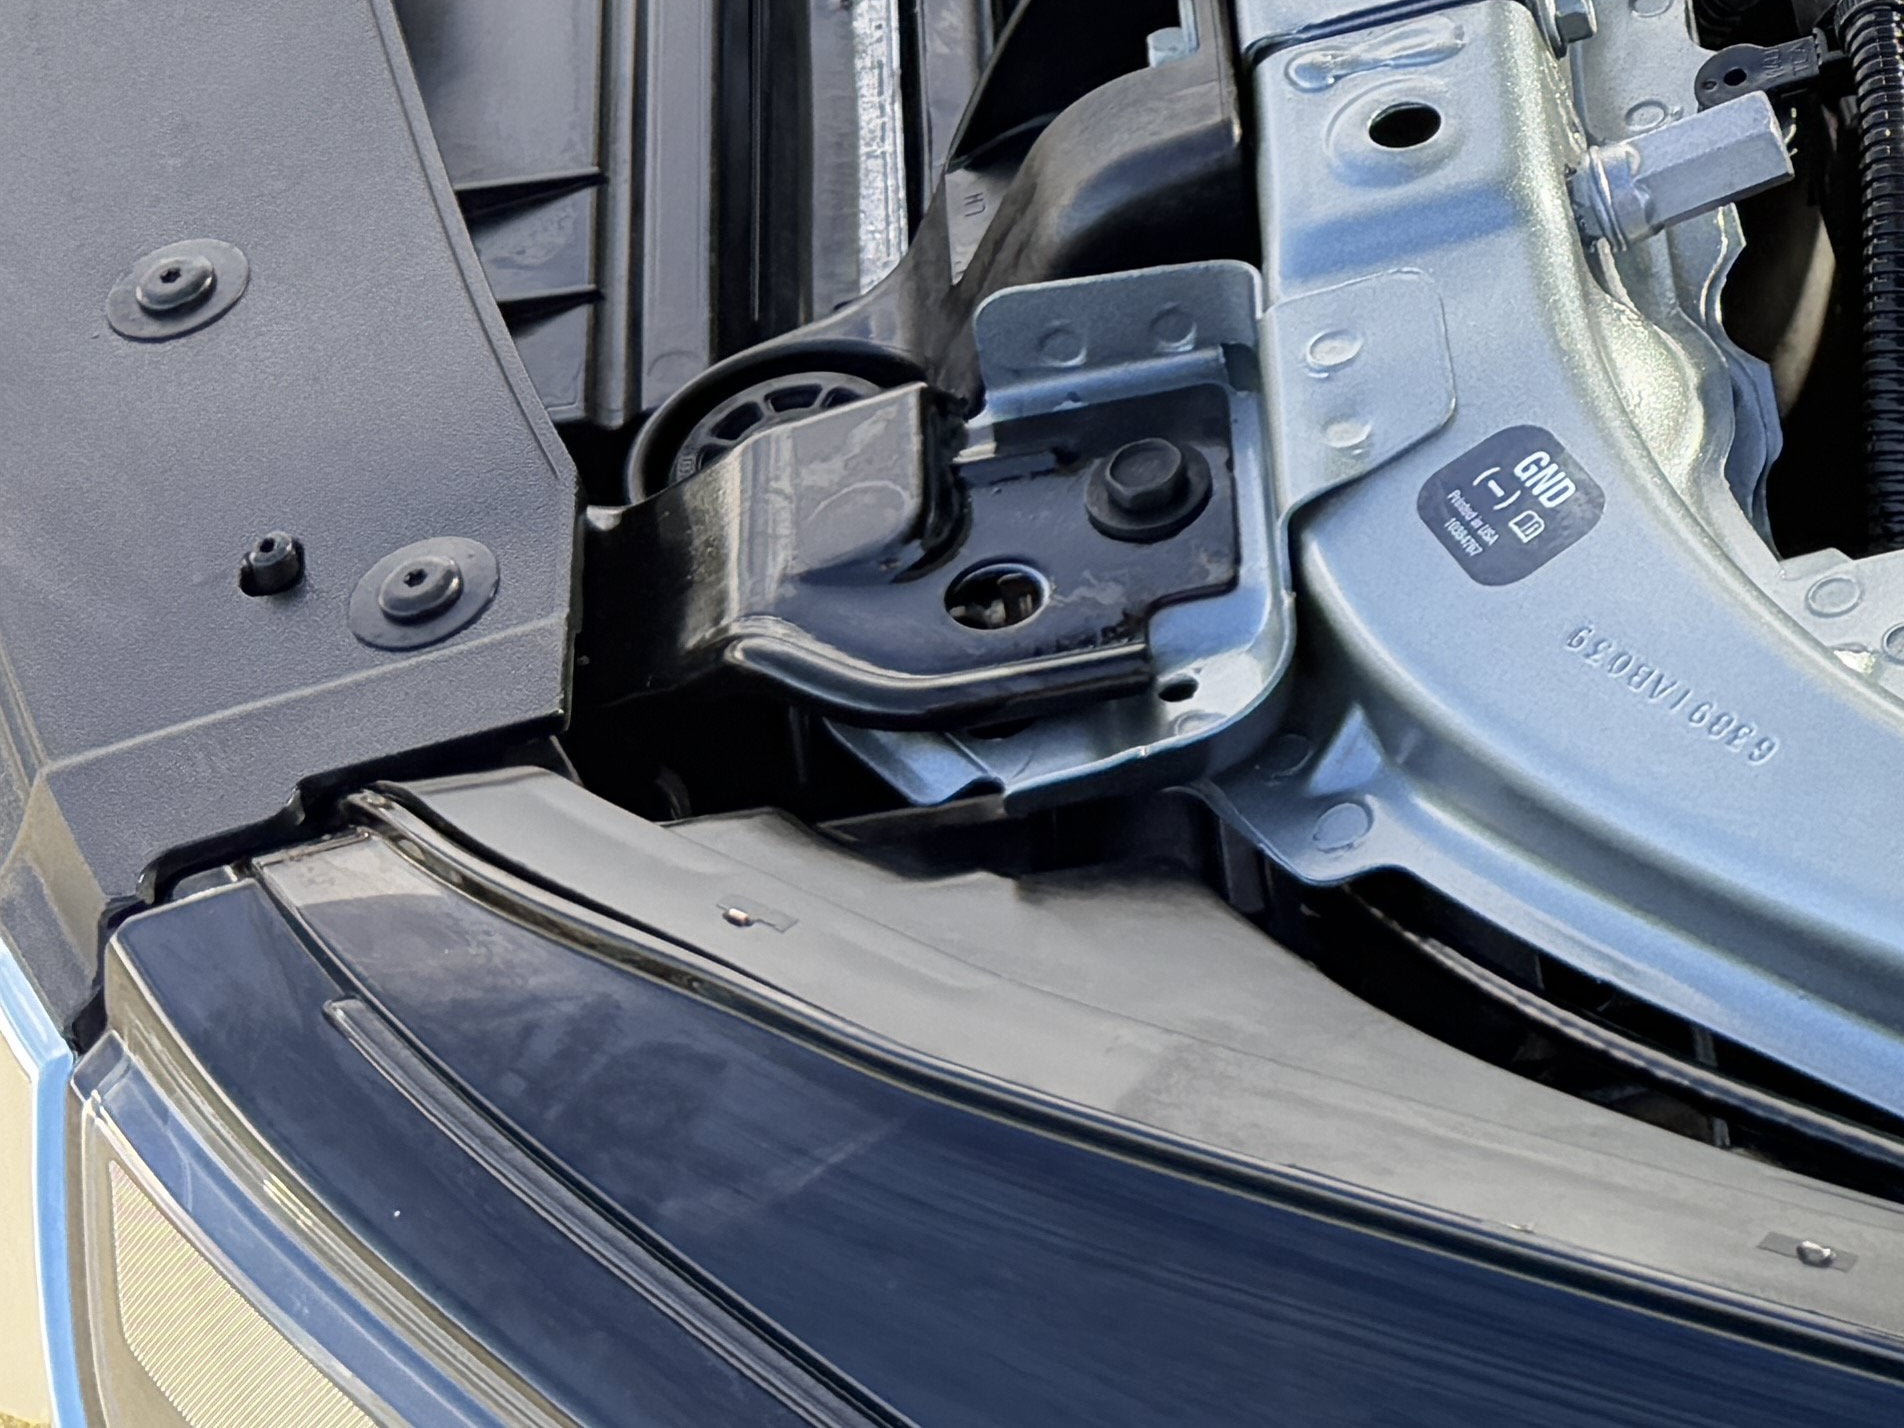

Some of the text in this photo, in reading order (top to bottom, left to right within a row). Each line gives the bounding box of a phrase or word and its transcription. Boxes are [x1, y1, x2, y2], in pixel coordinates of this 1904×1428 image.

[964, 191, 987, 218] LH
[1512, 449, 1577, 509] GND
[1476, 523, 1500, 546] USA
